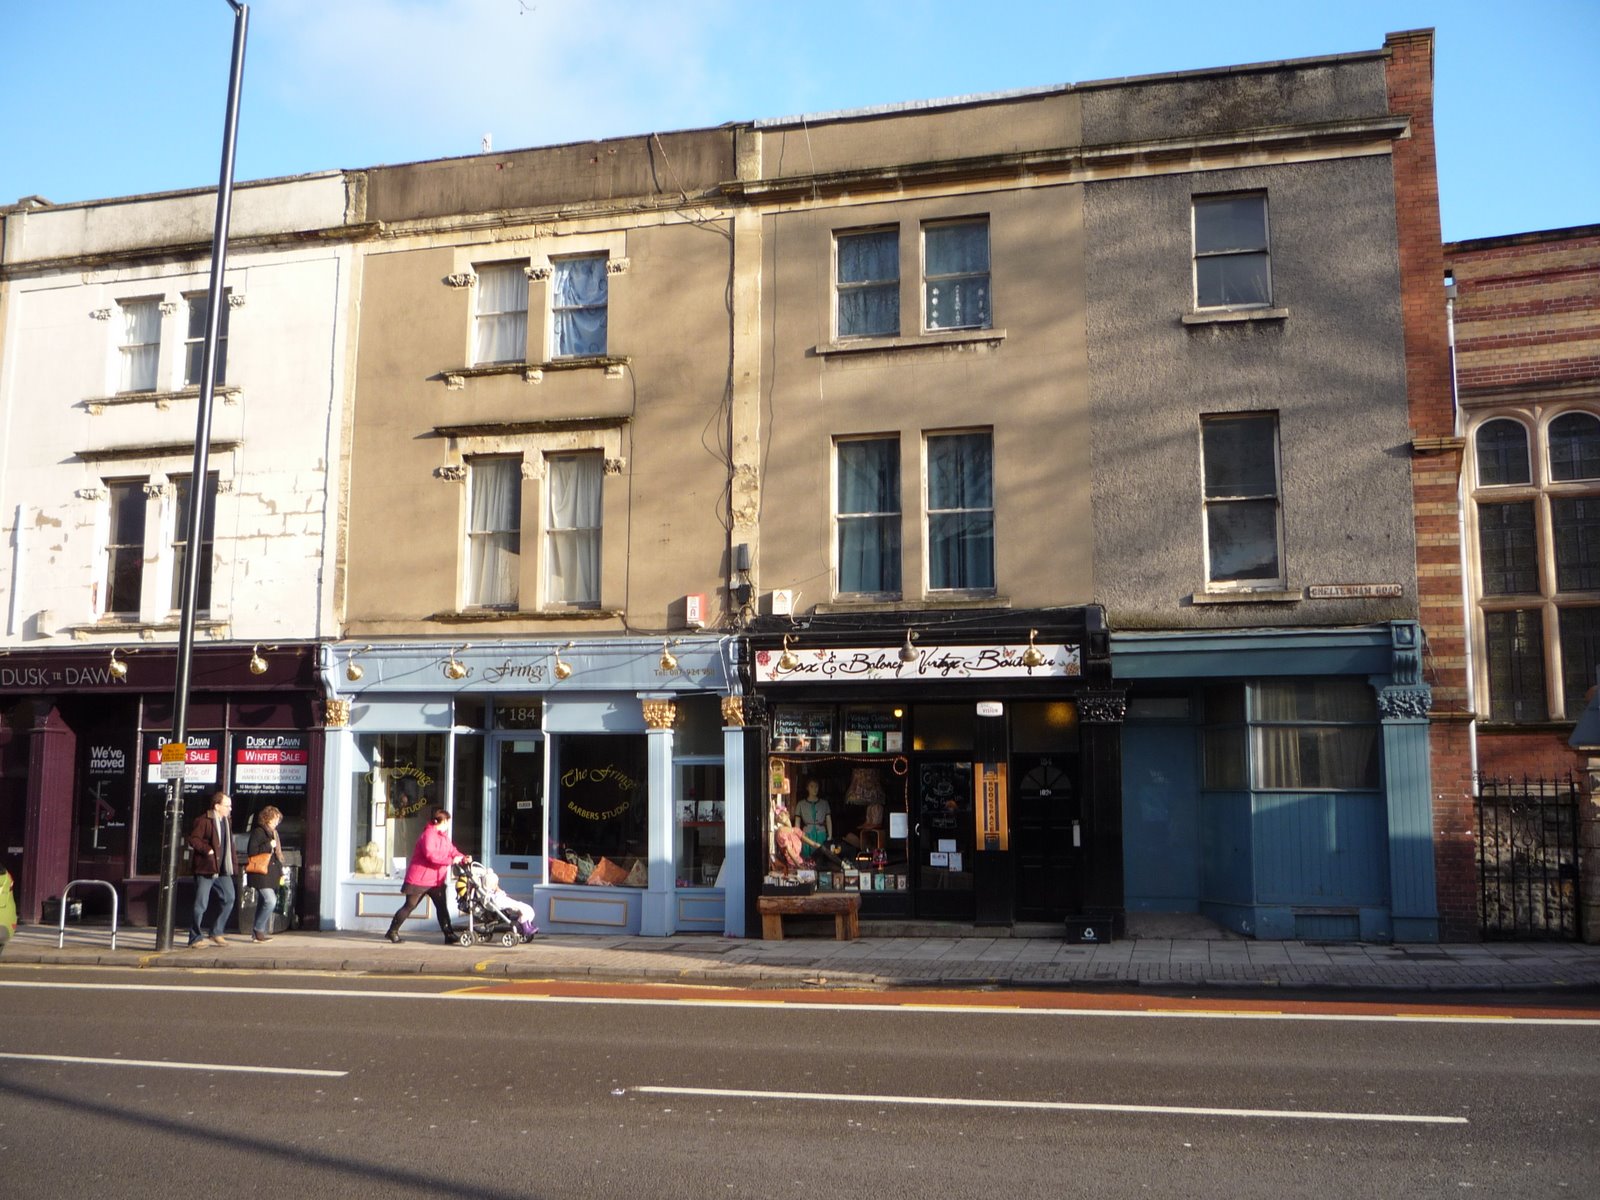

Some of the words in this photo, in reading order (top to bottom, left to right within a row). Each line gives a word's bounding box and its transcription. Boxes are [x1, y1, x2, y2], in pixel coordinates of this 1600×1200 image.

[1312, 586, 1372, 596] CHELTENHAM
[1375, 585, 1400, 595] ROAD
[822, 651, 837, 678] &
[963, 650, 1056, 675] Boutue
[1, 668, 49, 685] DUSK
[438, 660, 474, 679] Te
[482, 659, 548, 684] Fringe
[510, 708, 535, 721] 184
[187, 737, 210, 746] DAWN
[246, 736, 267, 746] DUSK
[277, 736, 300, 746] DAWN
[91, 746, 123, 759] We've
[190, 751, 210, 761] SALE
[245, 751, 278, 761] WINTER
[280, 752, 300, 762] SALE
[90, 754, 125, 768] moved
[391, 762, 434, 787] Fringe
[561, 768, 588, 787] The
[567, 801, 599, 820] BARBERS
[601, 801, 629, 820] STUDIO
